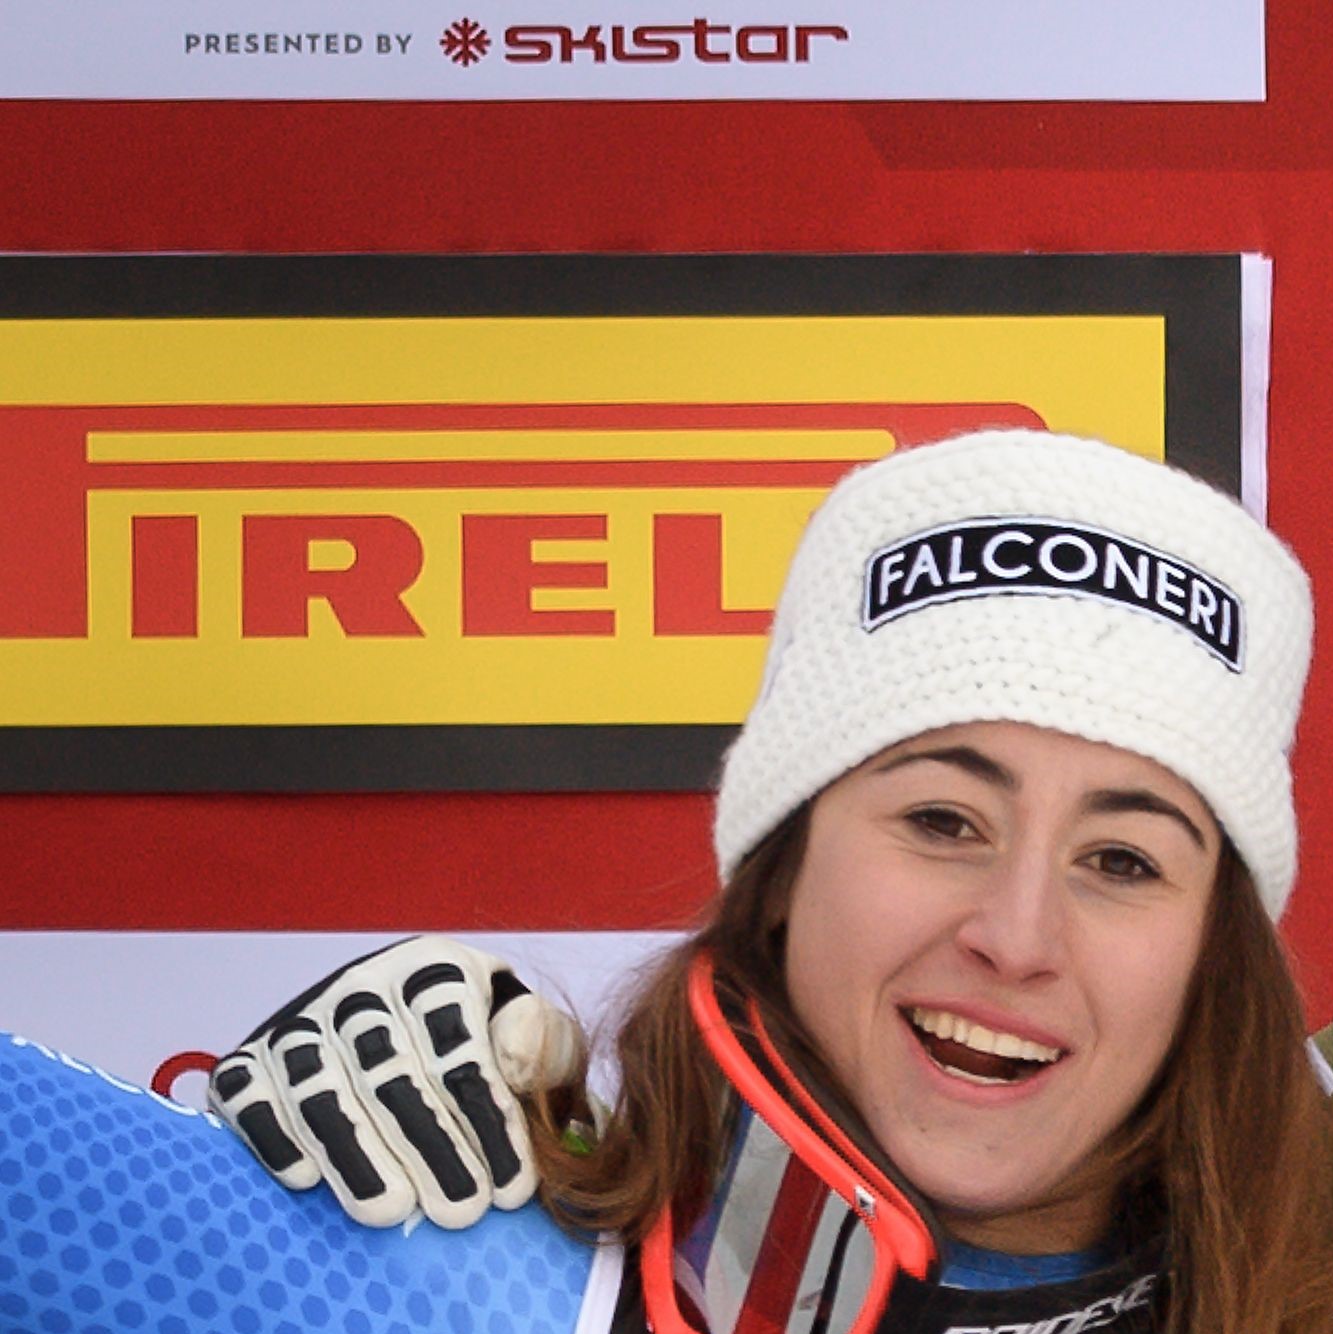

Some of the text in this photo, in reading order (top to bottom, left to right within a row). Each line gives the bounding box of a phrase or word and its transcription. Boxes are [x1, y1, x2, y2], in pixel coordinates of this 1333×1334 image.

[185, 33, 412, 54] PRESENTED BY
[879, 531, 1231, 646] FALCONERI
